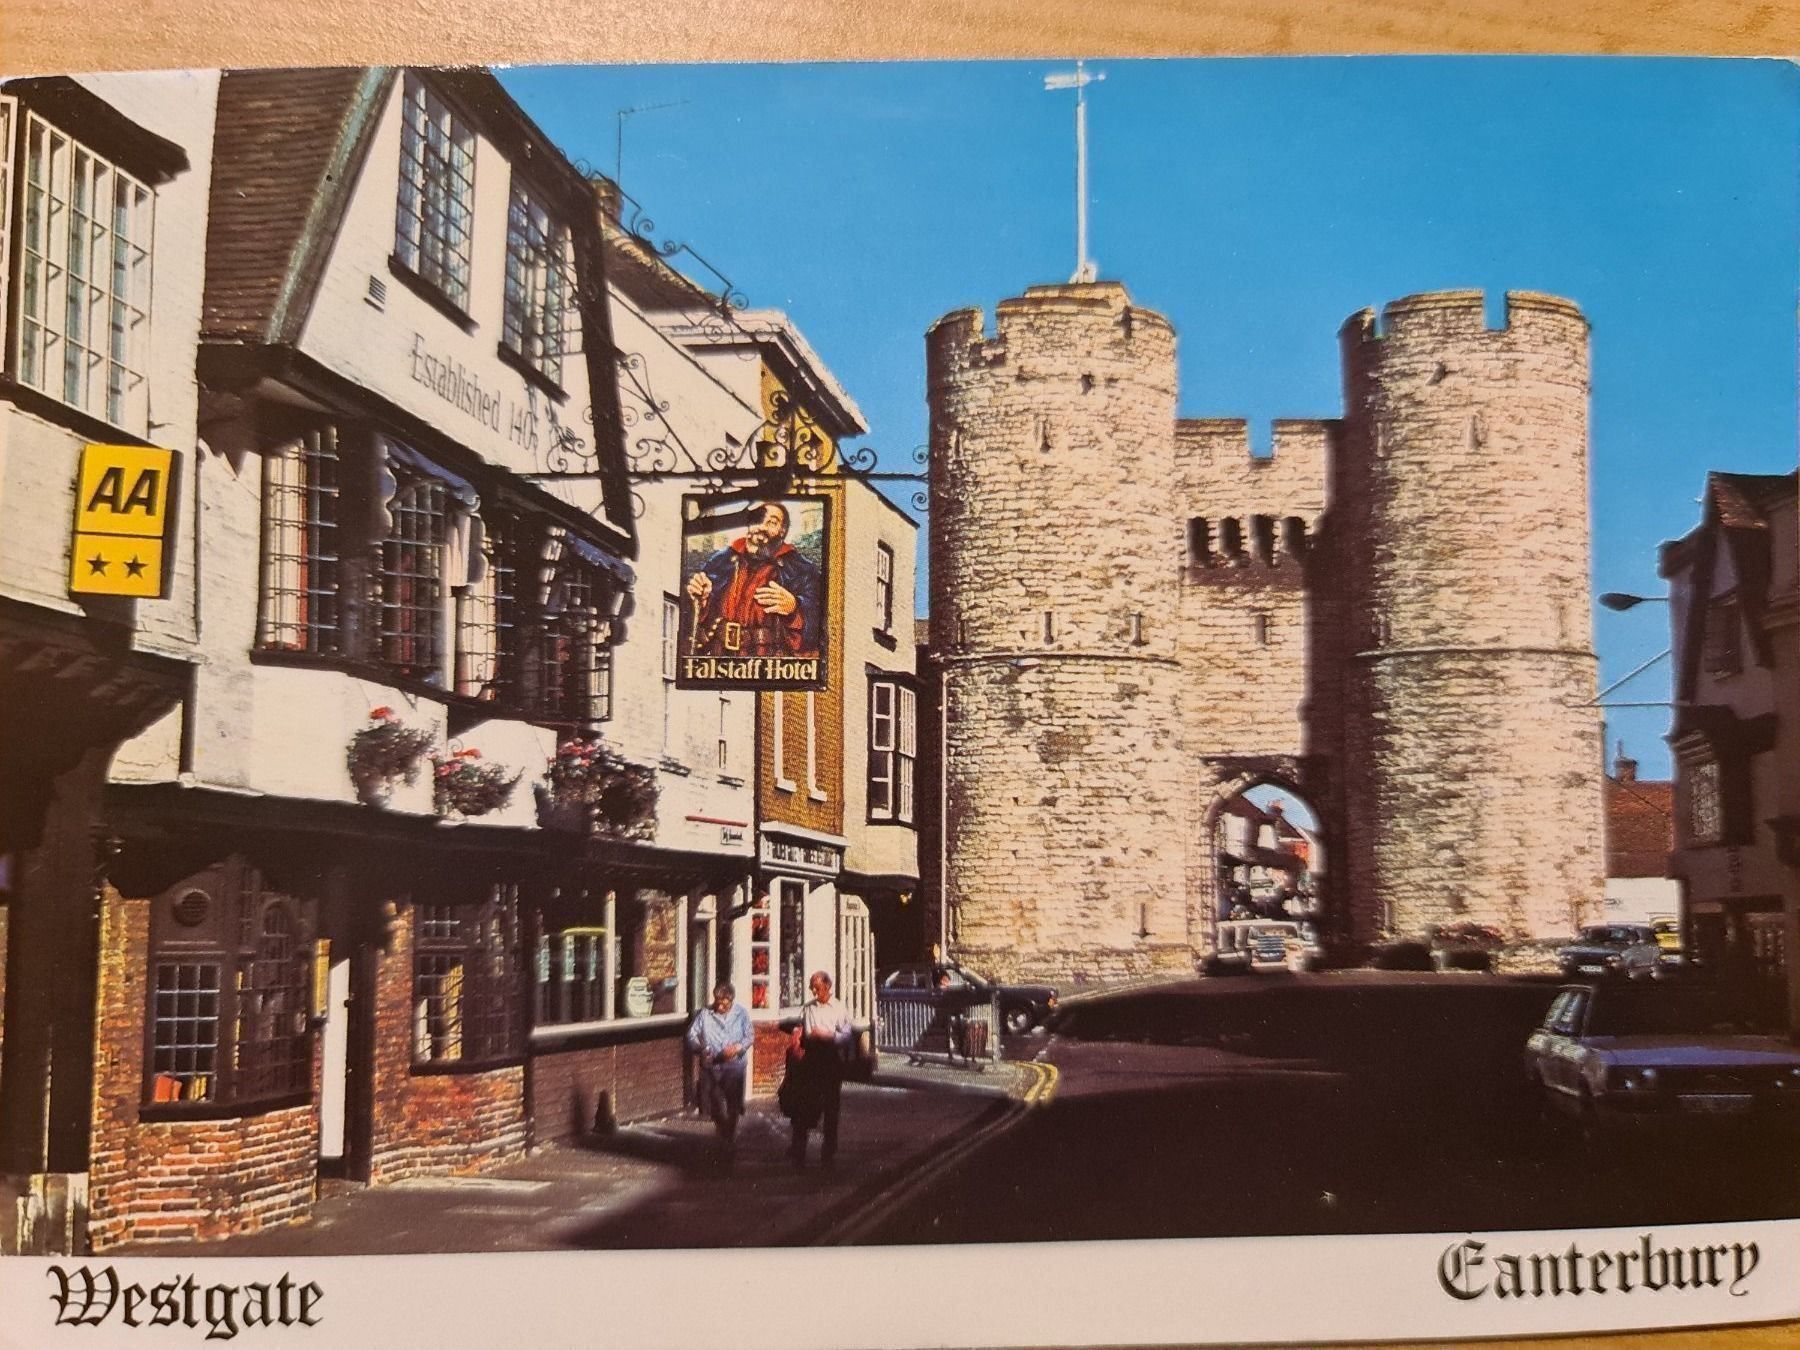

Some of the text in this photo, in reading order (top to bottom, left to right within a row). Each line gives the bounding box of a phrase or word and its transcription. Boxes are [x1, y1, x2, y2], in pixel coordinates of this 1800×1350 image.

[408, 332, 500, 433] Established
[87, 466, 161, 516] AA
[685, 658, 818, 681] Falstaff Hotel
[1437, 1232, 1760, 1301] Canterbury
[46, 1264, 325, 1340] Westgate
